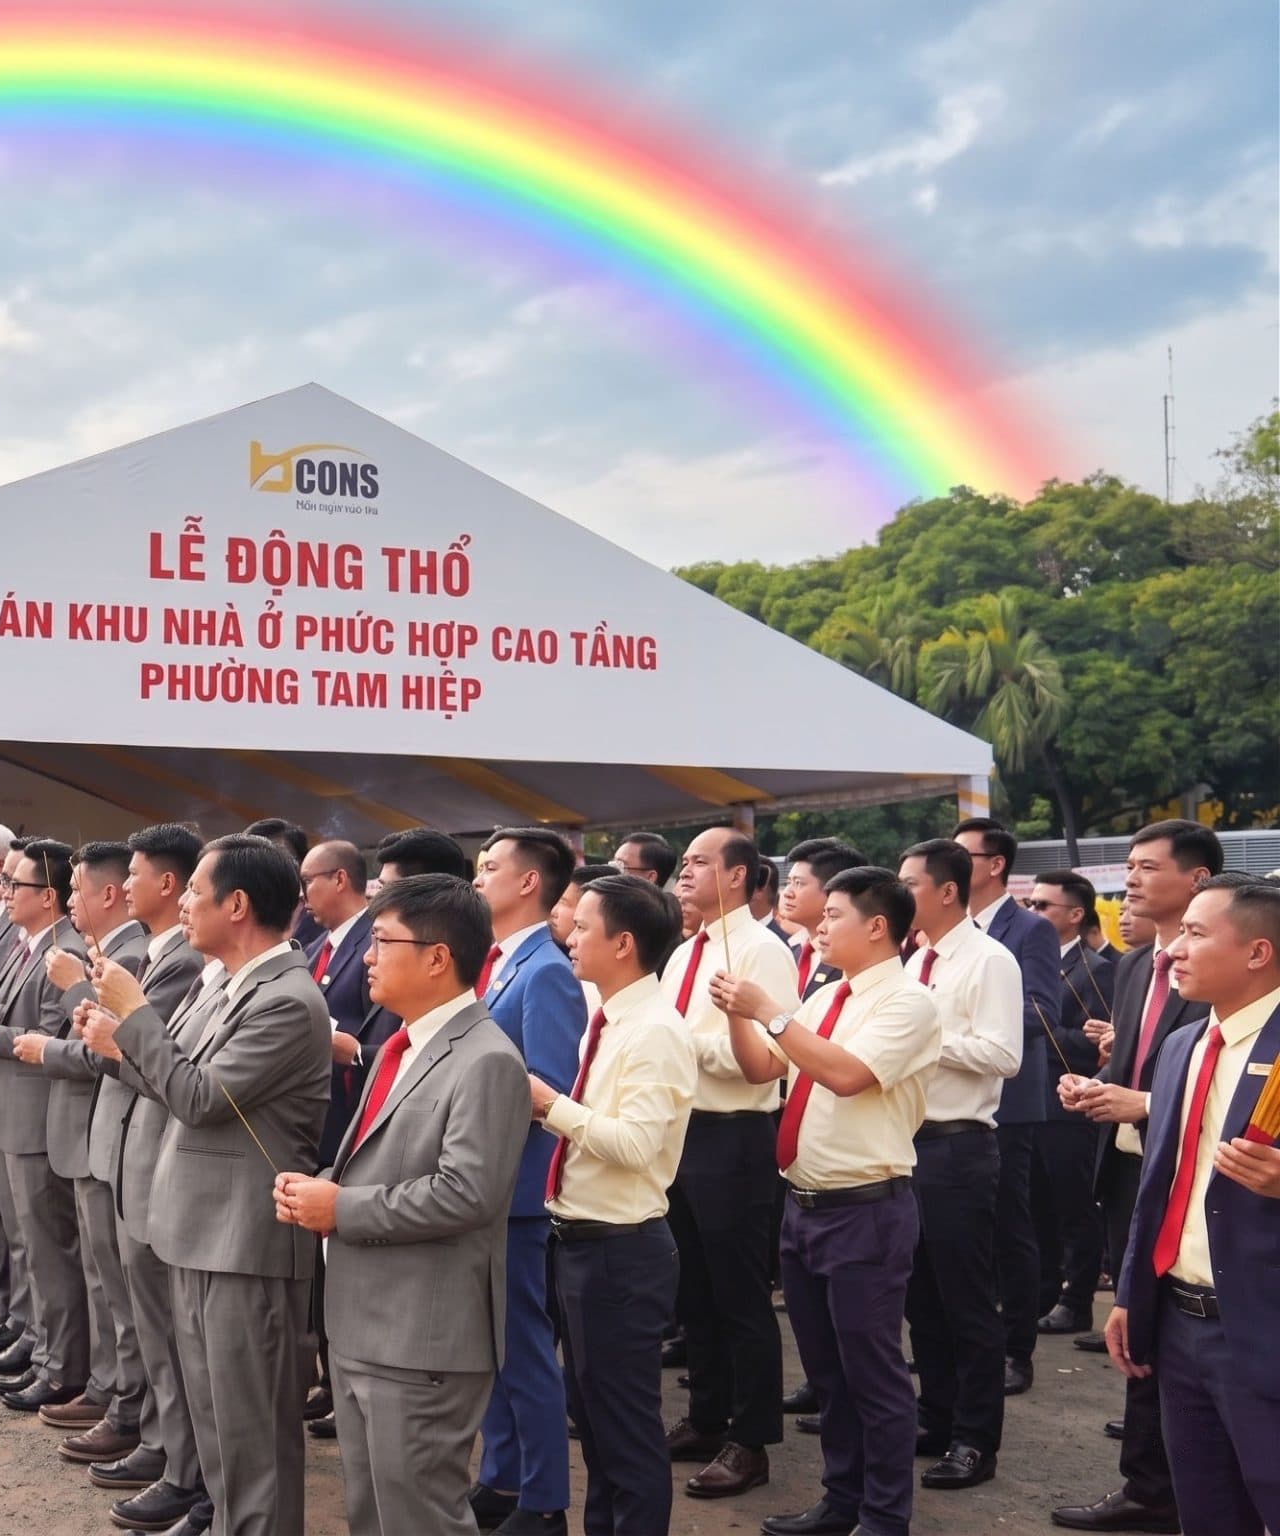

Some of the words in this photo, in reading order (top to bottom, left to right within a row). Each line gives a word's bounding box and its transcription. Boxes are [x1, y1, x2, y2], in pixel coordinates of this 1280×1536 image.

[149, 516, 206, 581] LỄ
[225, 529, 364, 597] ĐỘNG
[382, 534, 475, 598] THỔ
[68, 603, 149, 645] KHU
[163, 603, 244, 648] NHÀ
[257, 600, 284, 651] Ở
[295, 610, 395, 656] PHỨC
[408, 620, 479, 669] HỢP
[492, 625, 559, 666] CAO
[570, 620, 658, 672] TẦNG
[140, 657, 300, 706] PHƯỜNG
[312, 669, 388, 710] TAM
[401, 669, 482, 720] HIỆP
